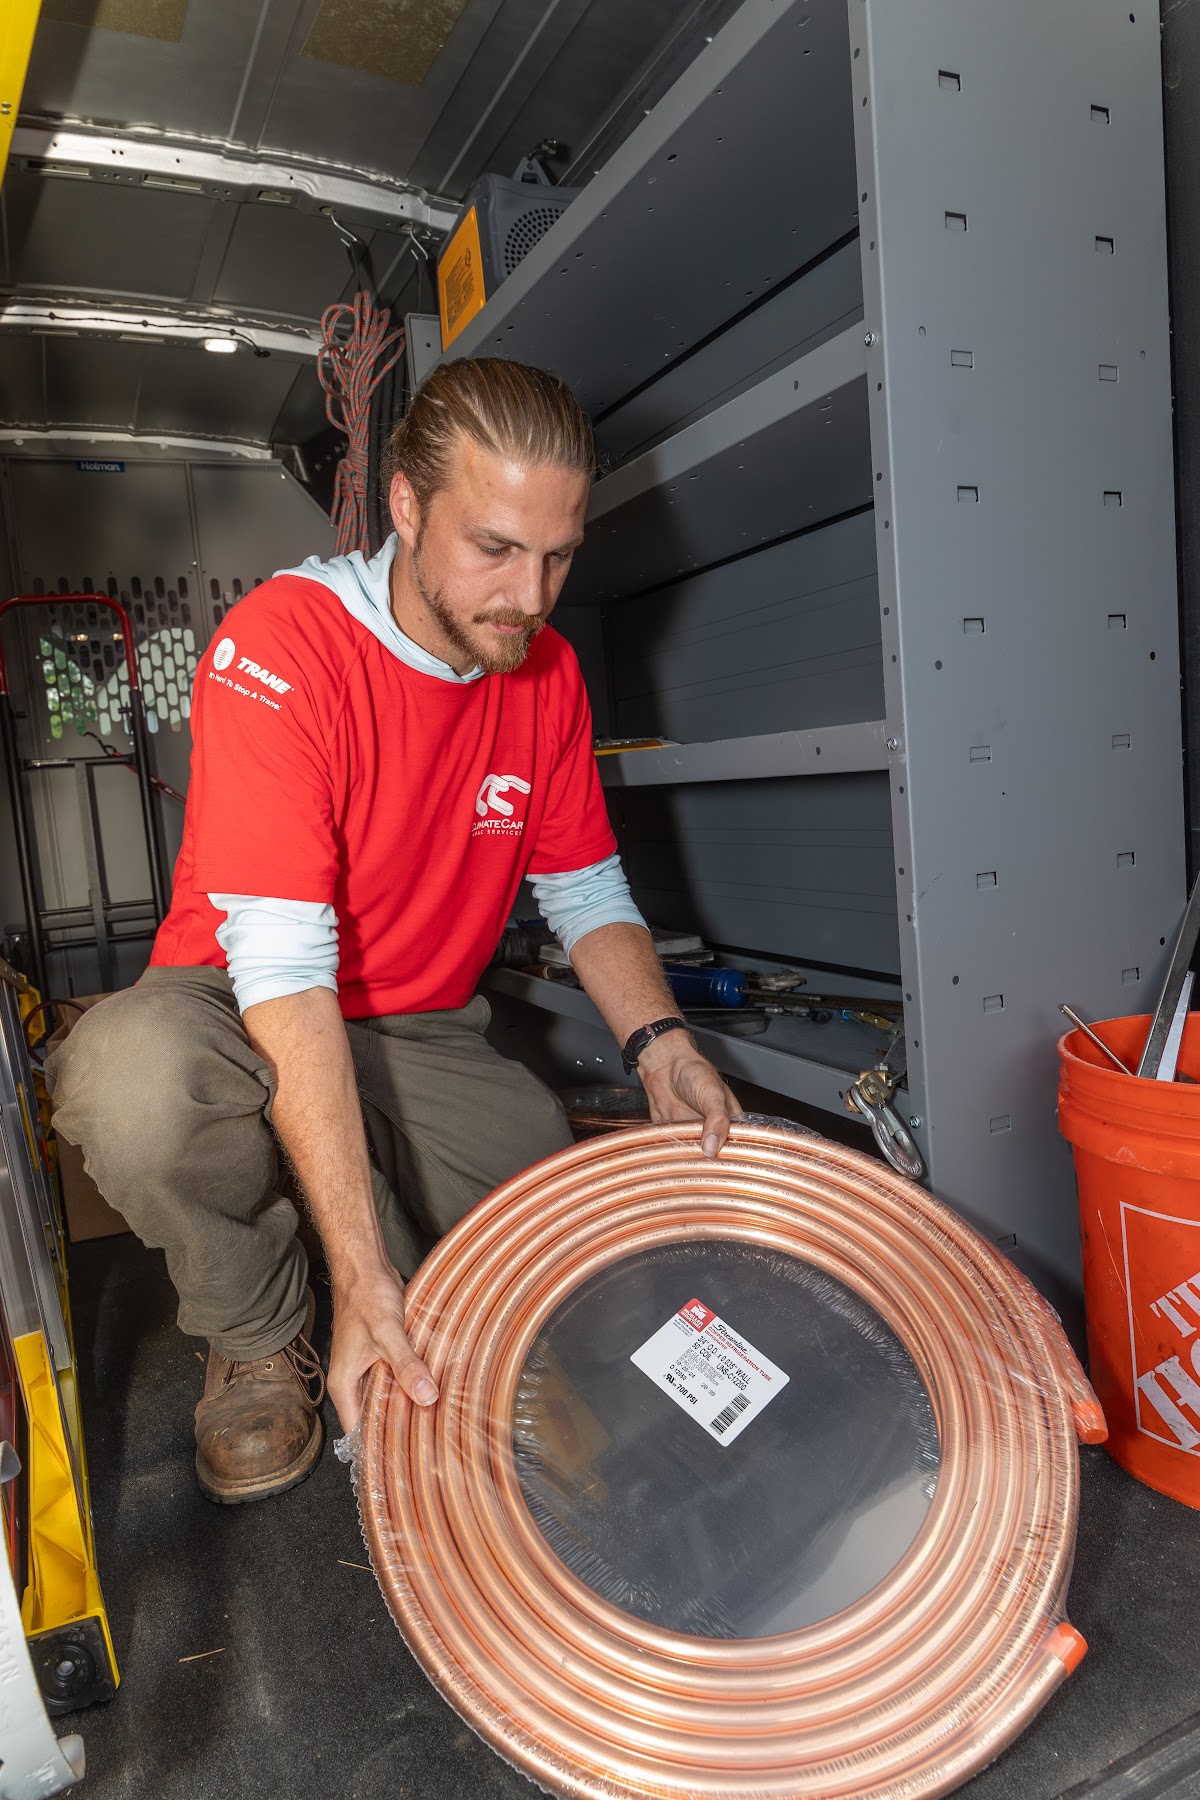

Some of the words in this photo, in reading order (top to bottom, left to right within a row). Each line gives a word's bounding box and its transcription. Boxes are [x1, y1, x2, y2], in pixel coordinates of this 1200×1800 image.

[80, 461, 121, 471] Holman
[215, 674, 227, 684] Hard
[226, 679, 234, 688] To
[233, 682, 250, 696] Stop
[250, 691, 258, 699] A
[236, 656, 292, 695] TRANE
[624, 1164, 665, 1176] Industries
[537, 1220, 564, 1241] Mueller
[566, 1198, 604, 1221] Industries
[629, 1201, 672, 1214] Industries
[707, 1326, 727, 1343] COPPER
[725, 1341, 760, 1372] REFRIGERATION
[759, 1370, 772, 1382] TUBE
[712, 1320, 751, 1355] Streamline
[697, 1335, 710, 1347] 3/4"
[720, 1355, 738, 1372] 0.035"
[734, 1368, 753, 1385] WALL
[698, 1348, 713, 1361] COIL
[715, 1362, 747, 1391] UNS-C12200
[675, 1383, 689, 1396] 700
[686, 1393, 698, 1405] PSI
